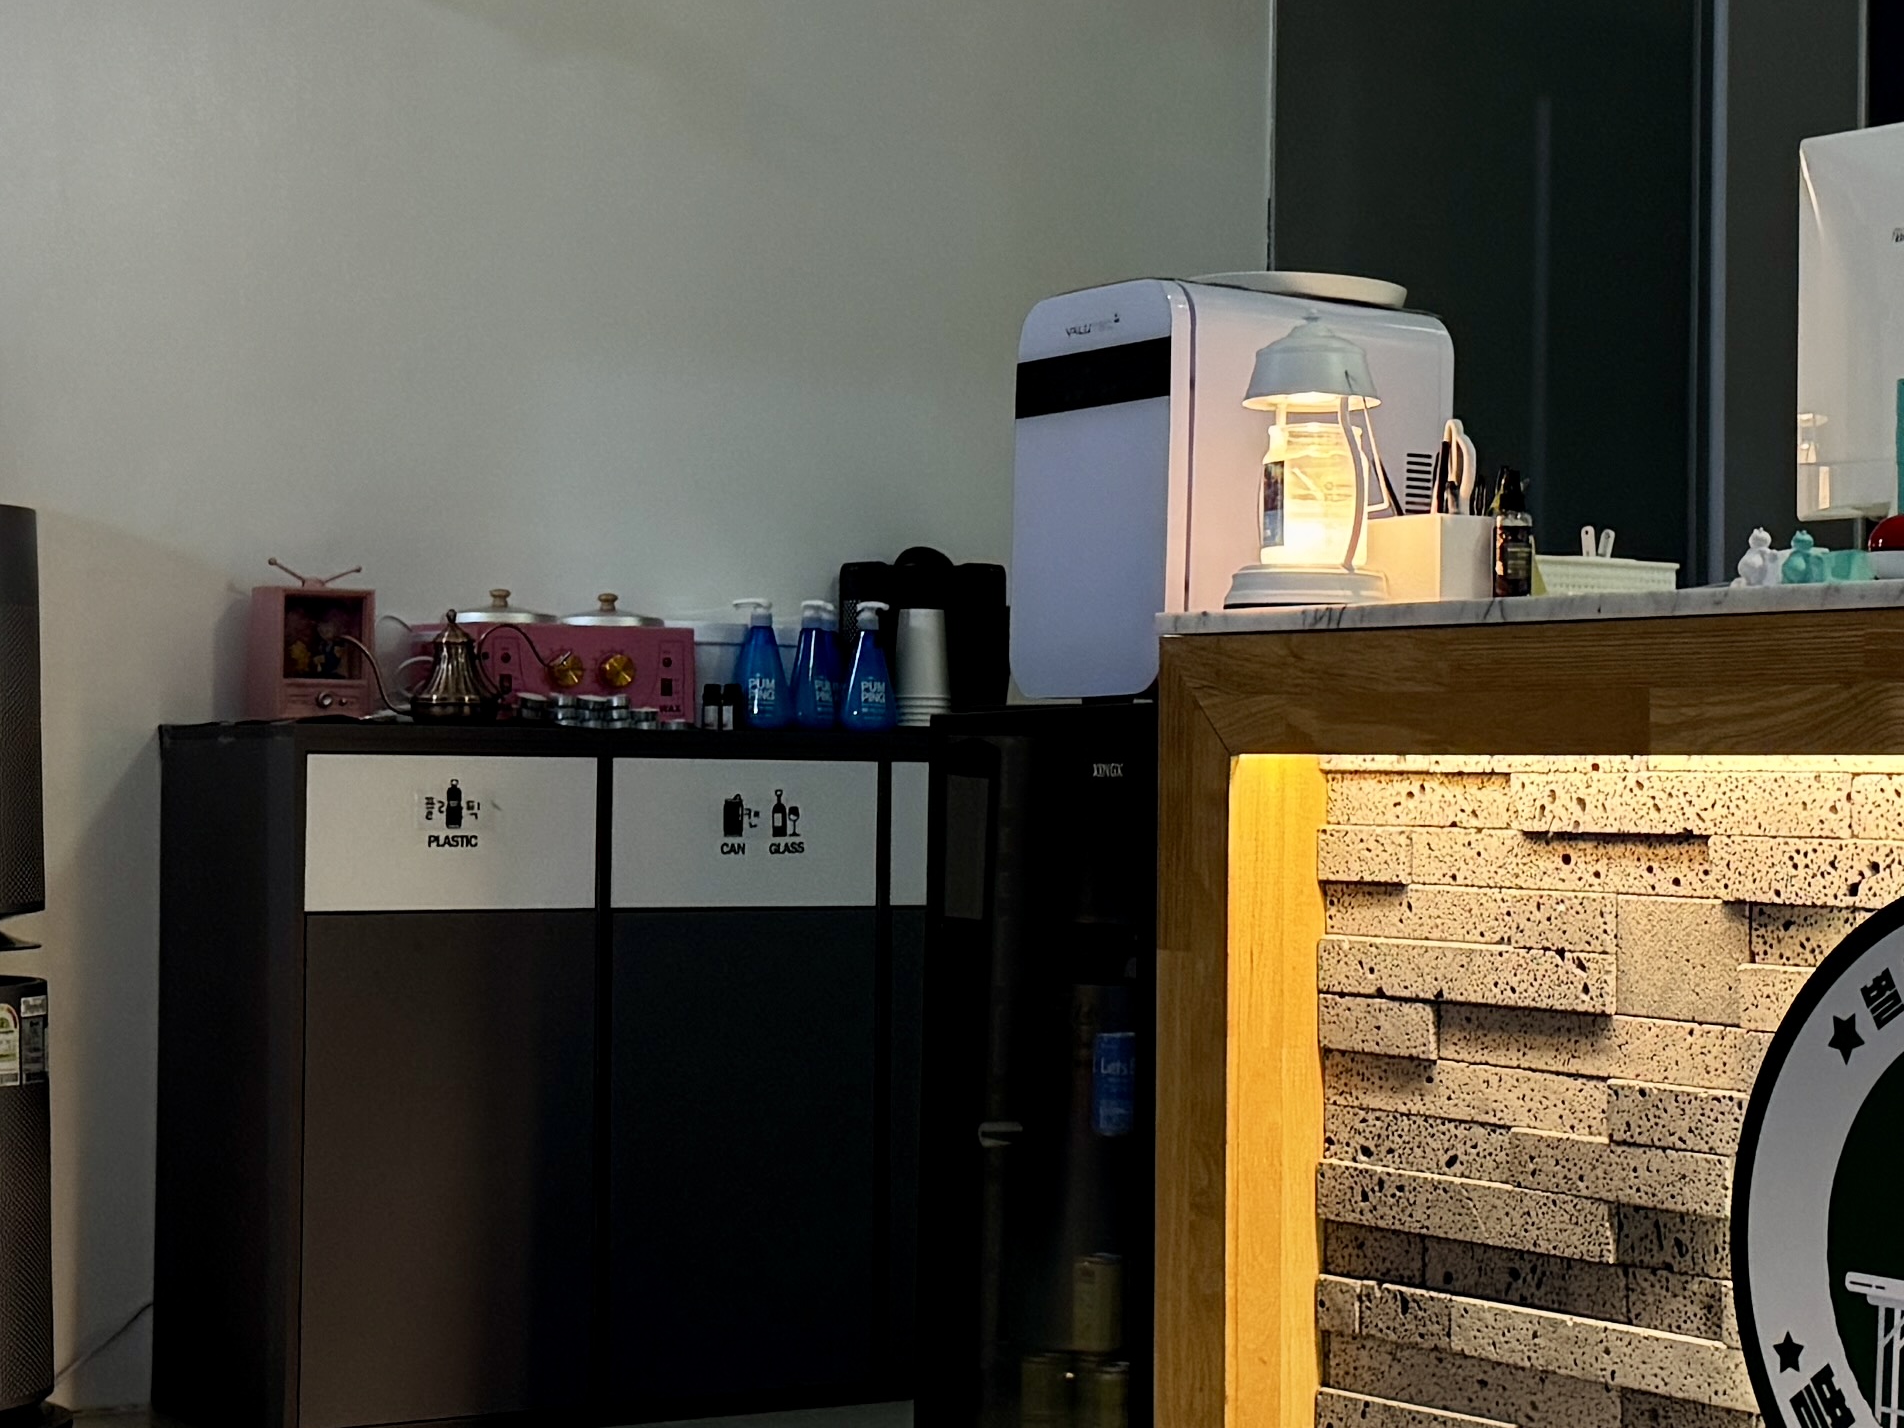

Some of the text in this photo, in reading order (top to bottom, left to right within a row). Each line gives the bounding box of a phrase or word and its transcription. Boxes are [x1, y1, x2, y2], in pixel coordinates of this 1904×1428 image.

[428, 835, 478, 847] PLASTIC
[721, 842, 805, 855] CAN GLASS
